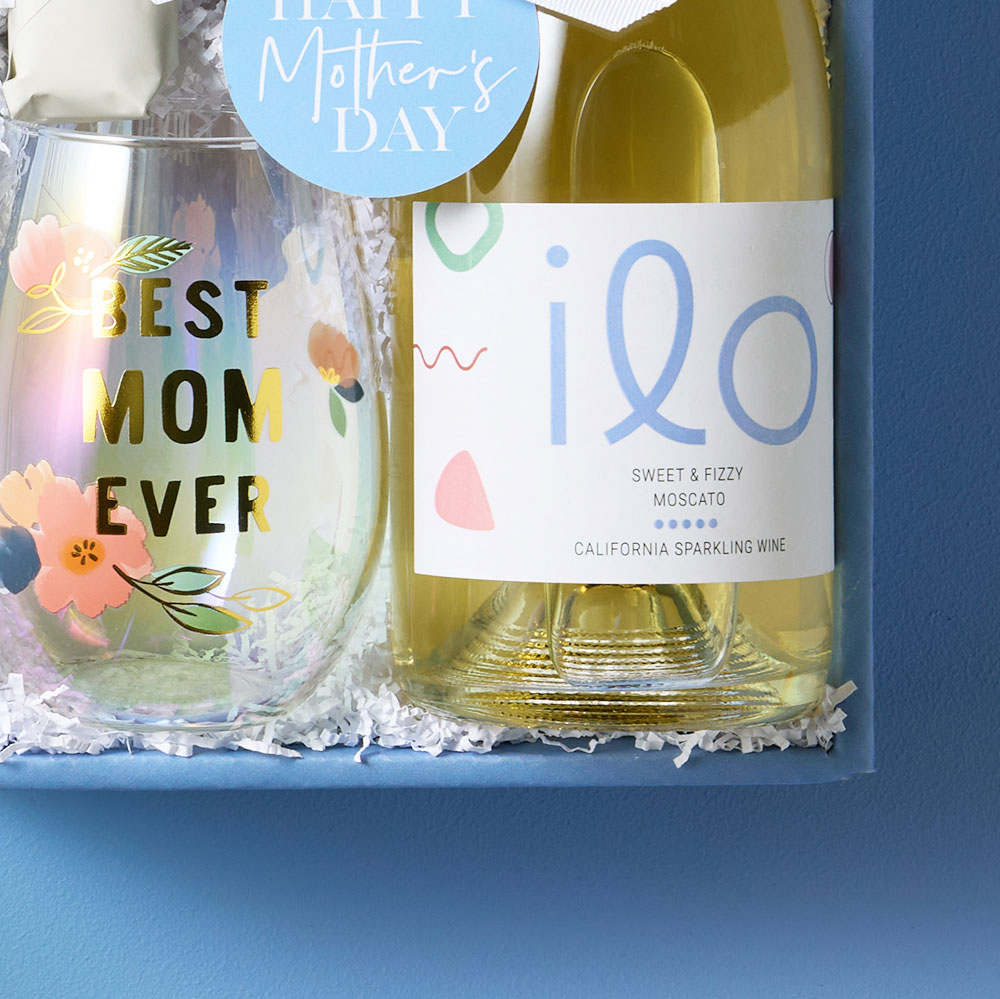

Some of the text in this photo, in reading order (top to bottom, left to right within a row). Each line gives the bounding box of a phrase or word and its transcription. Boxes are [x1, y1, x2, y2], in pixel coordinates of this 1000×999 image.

[258, 25, 518, 124] Mother's
[332, 106, 467, 153] DAY
[92, 277, 270, 339] BEST
[545, 239, 819, 446] ilo
[82, 368, 283, 445] MOM
[632, 466, 744, 483] SWEET & FIZZY
[653, 491, 726, 507] MOSCATO
[96, 475, 272, 537] EVER
[574, 537, 786, 556] CALIFORNIA SPARKLING WINE
